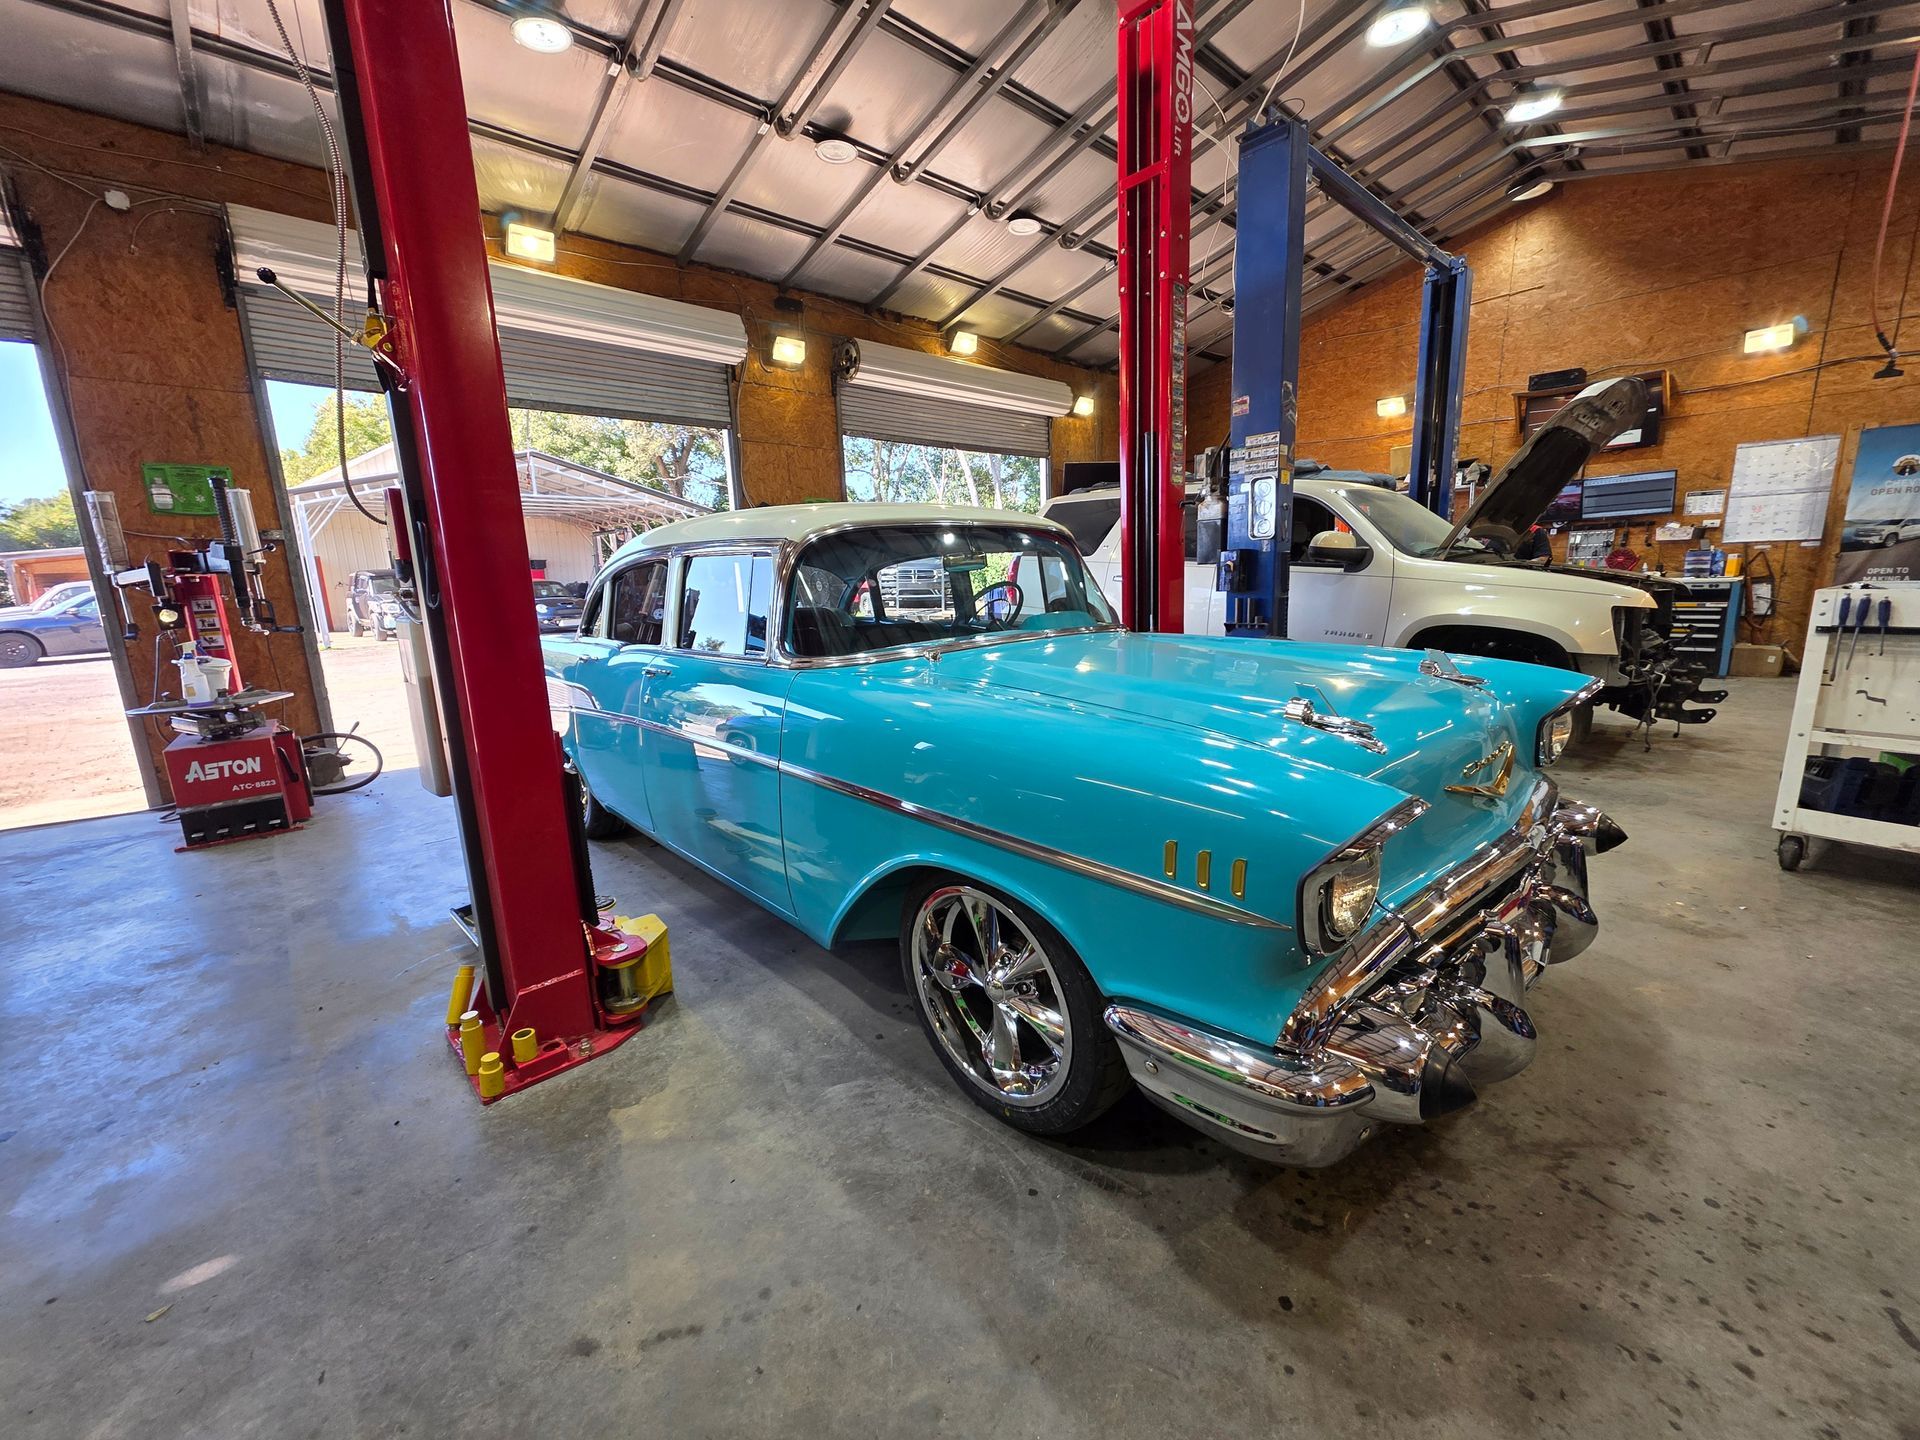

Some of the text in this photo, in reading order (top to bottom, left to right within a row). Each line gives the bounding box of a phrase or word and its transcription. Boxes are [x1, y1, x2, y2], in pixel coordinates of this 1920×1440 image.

[1175, 0, 1192, 124] AMGO
[1870, 487, 1901, 496] OPEN
[1867, 567, 1893, 575] OPEN
[185, 757, 260, 783] ASTON
